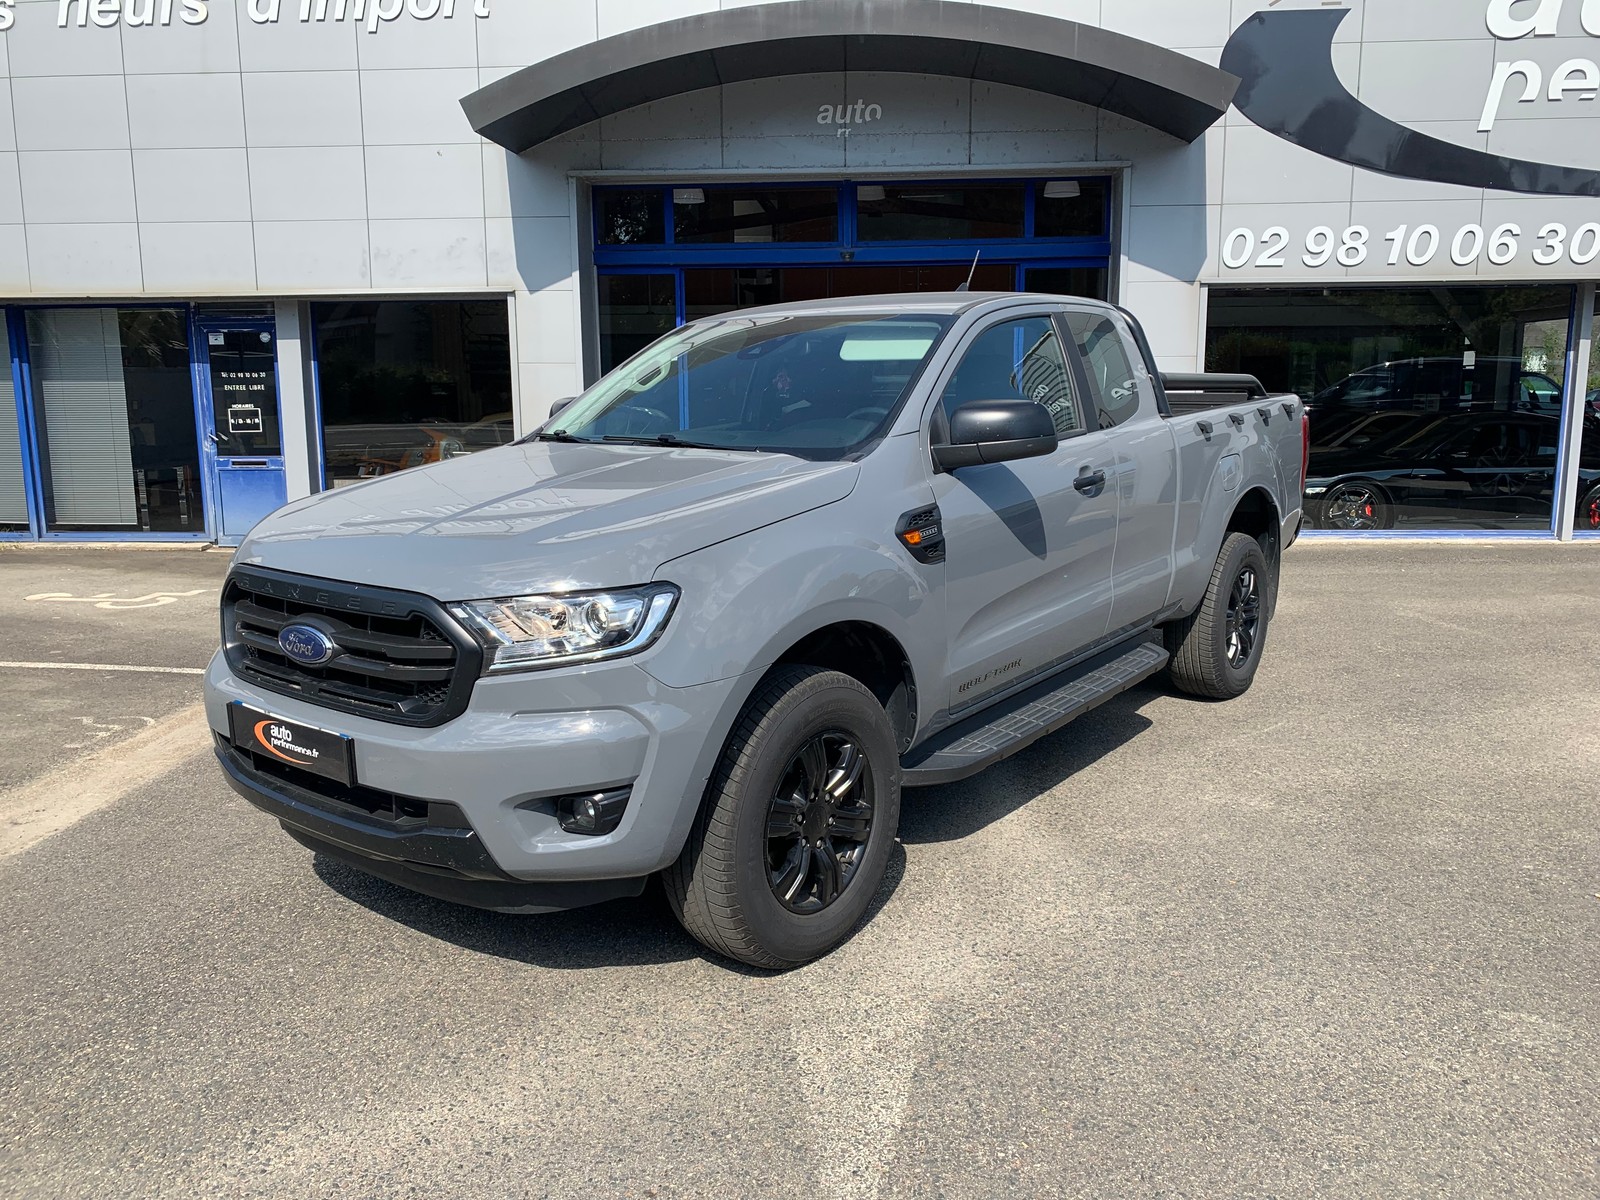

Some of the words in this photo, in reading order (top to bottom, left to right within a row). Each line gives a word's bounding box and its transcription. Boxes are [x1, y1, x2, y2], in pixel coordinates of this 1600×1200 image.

[816, 98, 883, 125] auto
[1222, 227, 1290, 268] 02
[1302, 225, 1370, 267] 98
[1384, 224, 1441, 267] 10
[1450, 223, 1521, 265] 06
[1531, 222, 1600, 265] 30
[285, 632, 316, 657] Ford
[270, 725, 293, 742] auto
